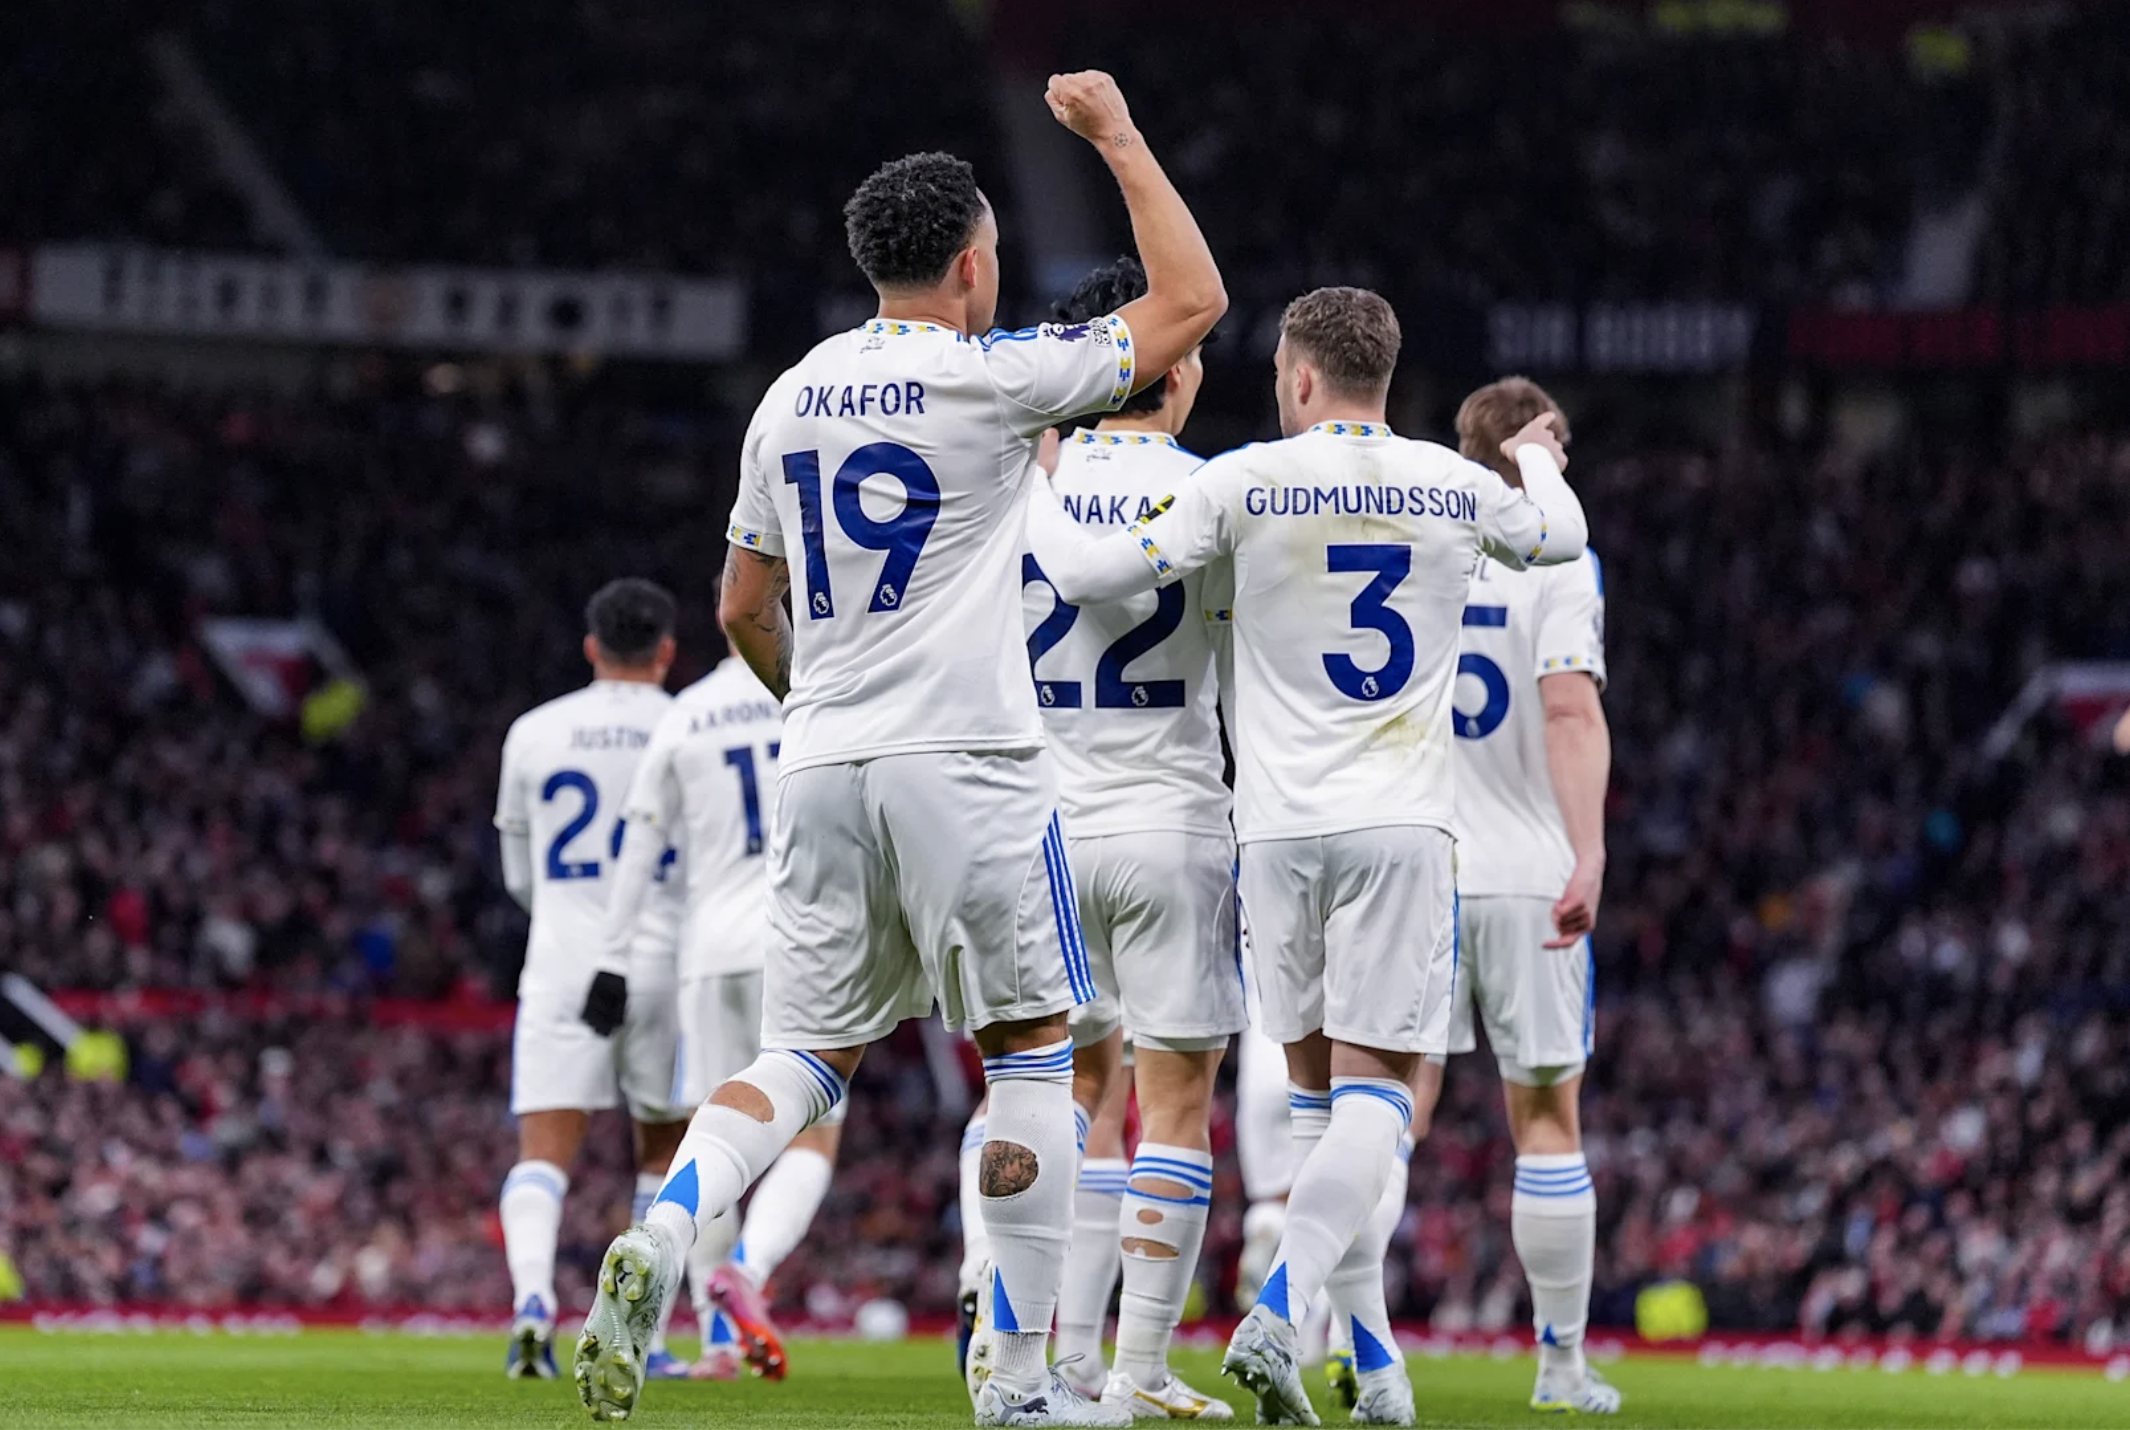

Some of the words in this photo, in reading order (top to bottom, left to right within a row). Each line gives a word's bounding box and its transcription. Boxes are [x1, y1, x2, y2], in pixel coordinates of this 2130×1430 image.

[795, 381, 926, 418] OKAFOR
[781, 441, 942, 621] 19
[1063, 494, 1151, 525] NAKA
[1245, 486, 1477, 522] GUDMUNDSSON
[1021, 552, 1186, 709] 22
[1321, 543, 1416, 702] 3
[723, 740, 781, 857] 1
